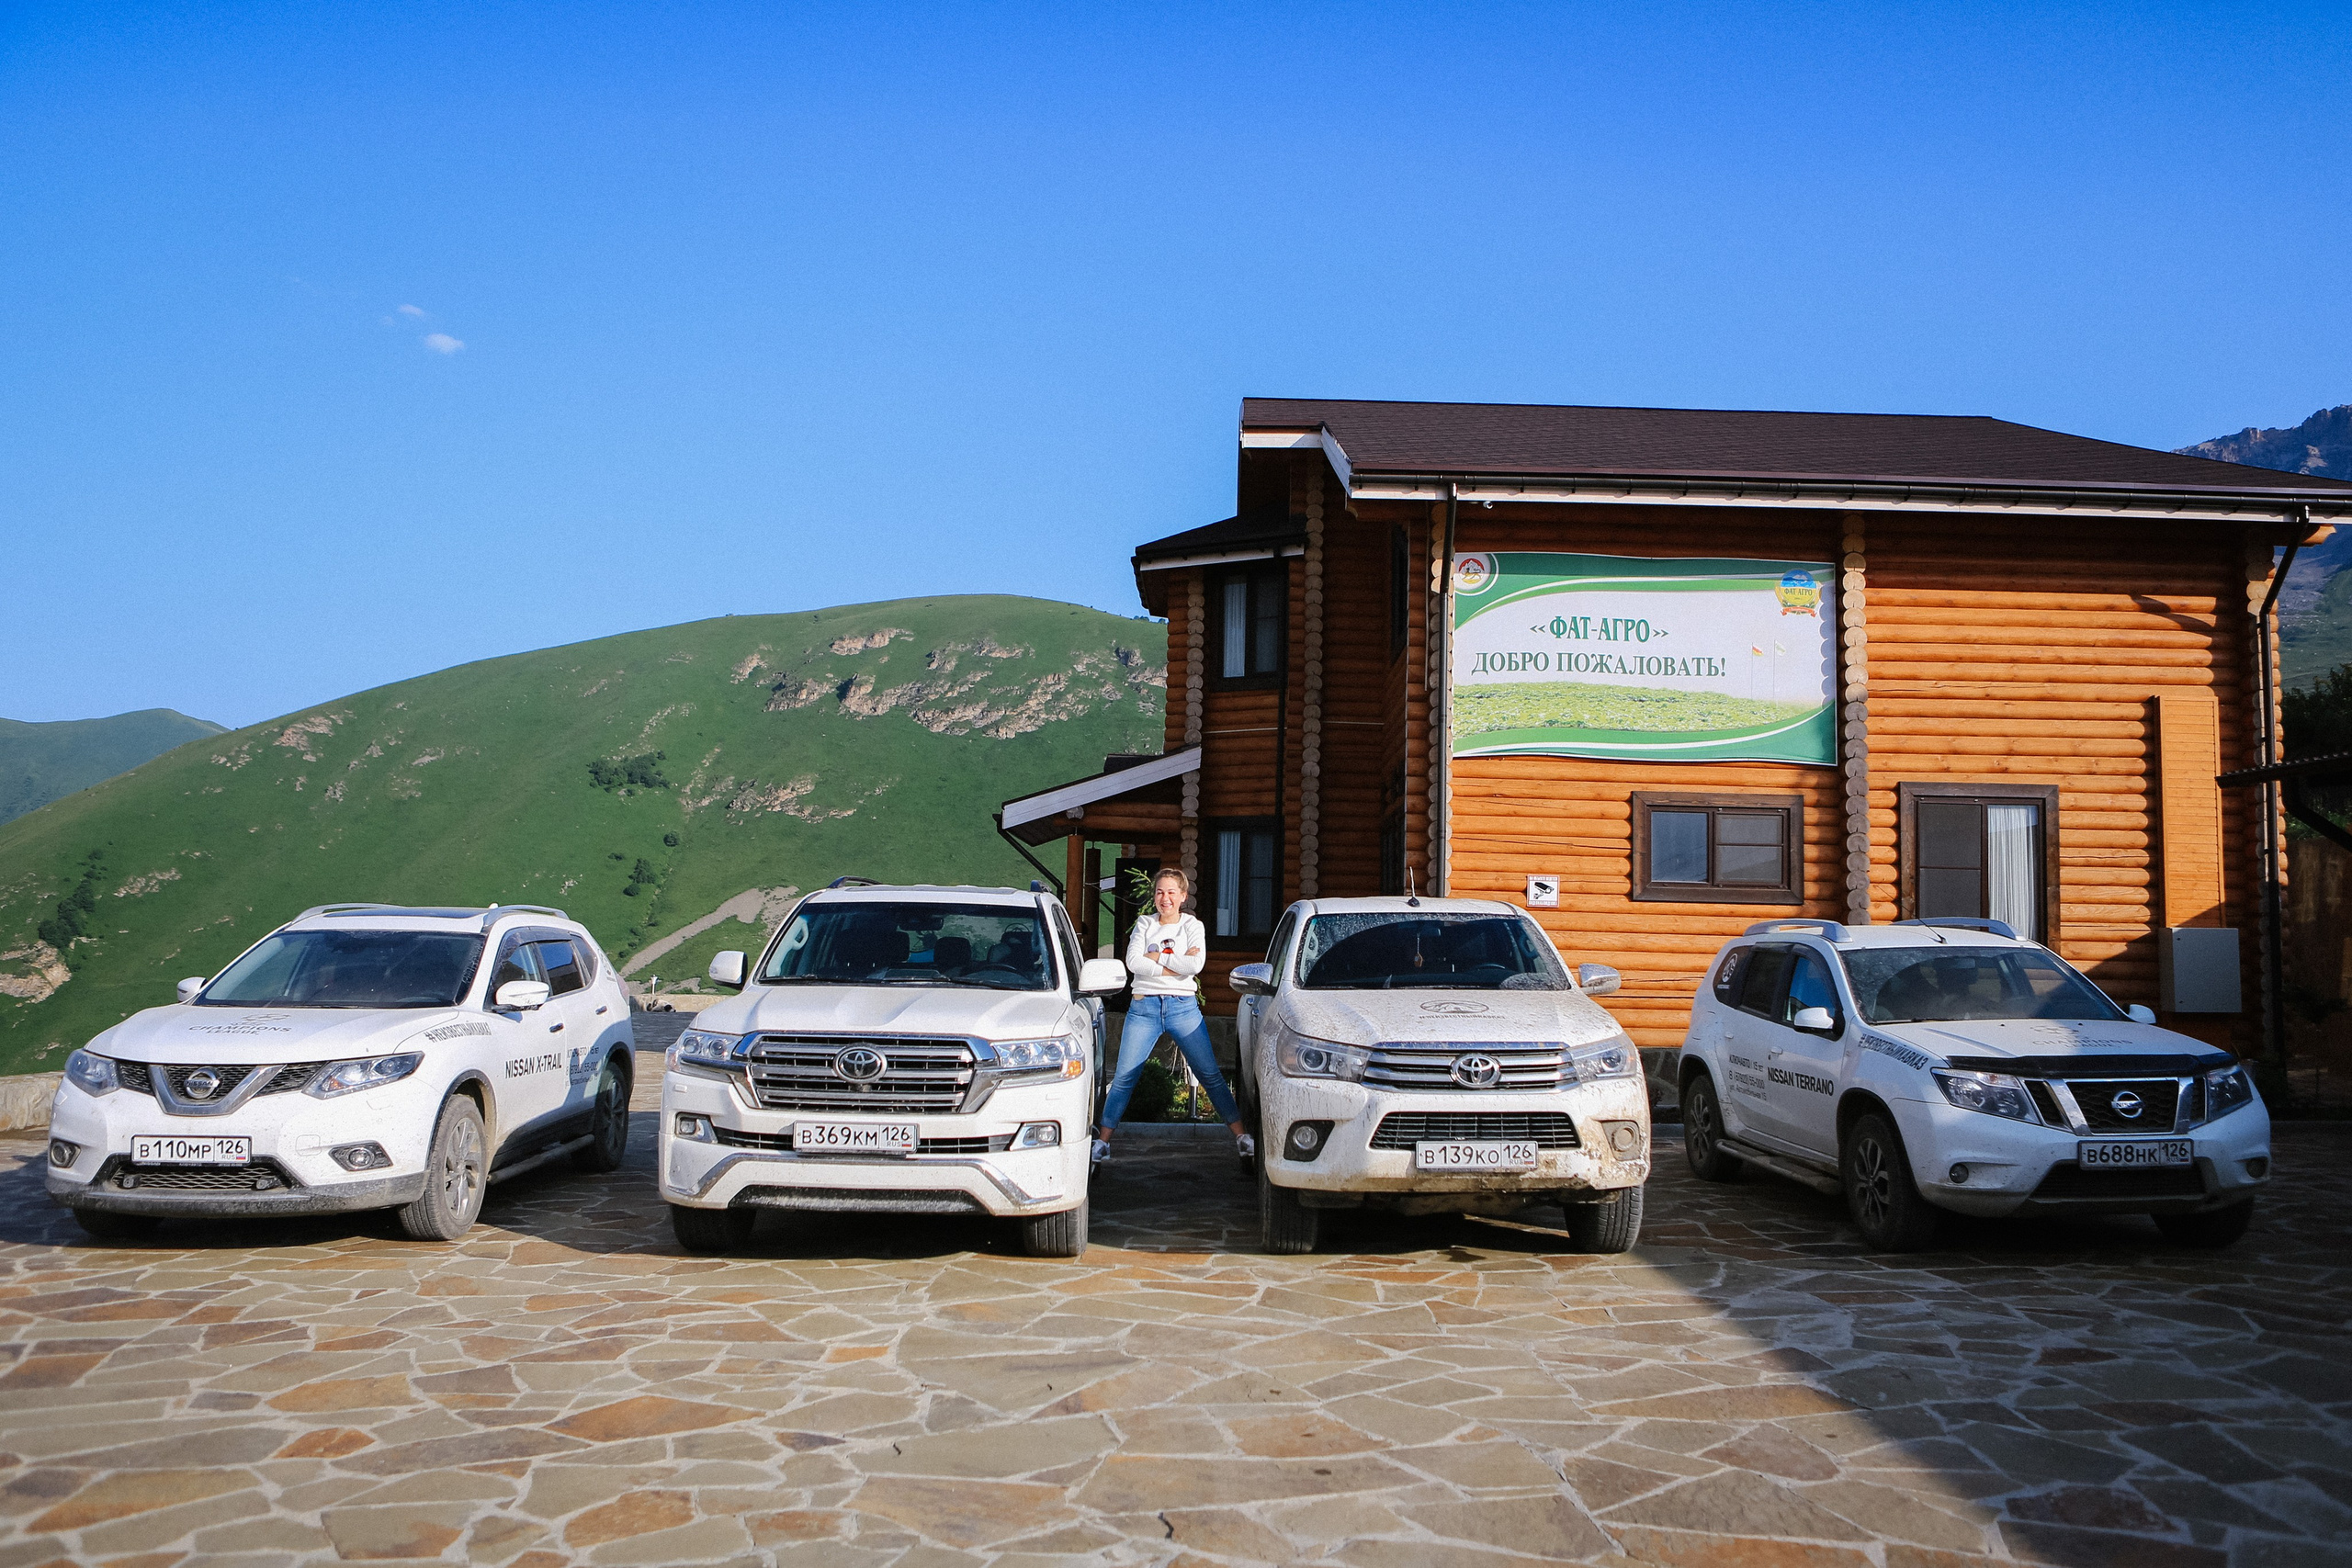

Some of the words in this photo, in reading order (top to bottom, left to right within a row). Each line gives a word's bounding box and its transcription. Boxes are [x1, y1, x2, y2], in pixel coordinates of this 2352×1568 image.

[1798, 588, 1813, 596] АГРО
[1471, 651, 1550, 675] ДОБРО
[1556, 652, 1726, 677] ПОЖАЛОВАТЬ!
[505, 1056, 535, 1079] NISSAN
[536, 1052, 562, 1074] X-TRAIL
[1767, 1066, 1794, 1087] NISSAN
[1795, 1072, 1835, 1097] TERRANO
[802, 1125, 877, 1146] В369КМ
[882, 1126, 910, 1142] 126
[140, 1140, 211, 1158] В110МР
[217, 1140, 243, 1154] 126
[1425, 1145, 1499, 1165] В139КО
[1503, 1145, 1532, 1159] 126
[2086, 1145, 2158, 1164] В688НК
[2161, 1143, 2187, 1157] 126
